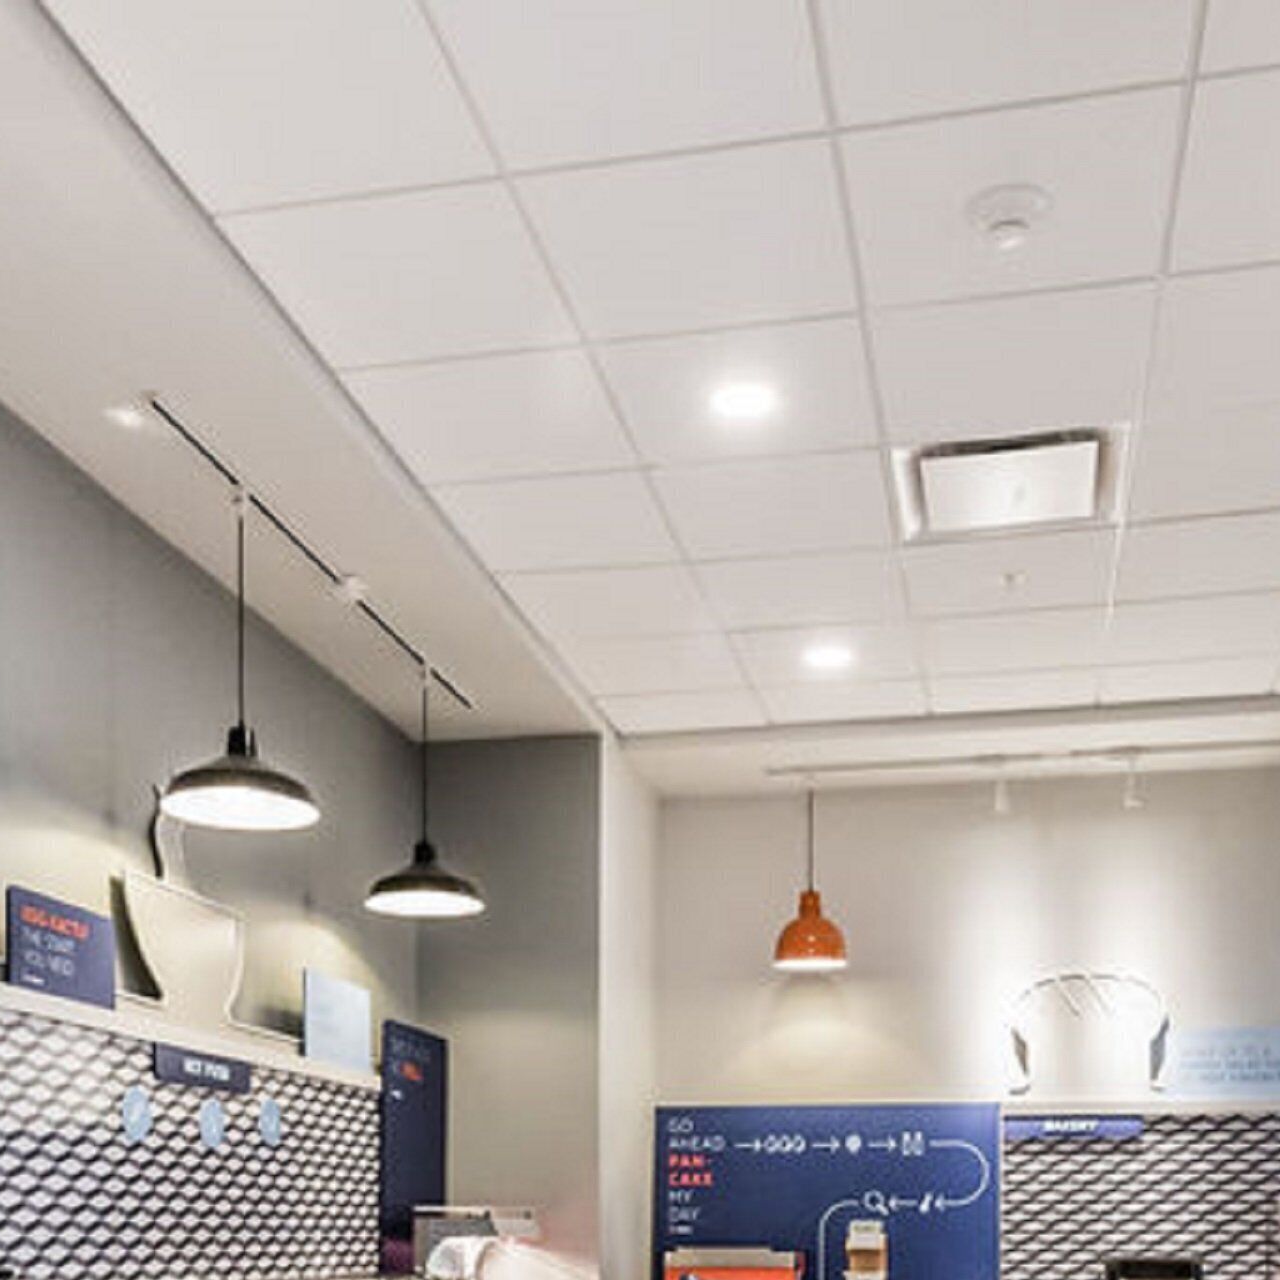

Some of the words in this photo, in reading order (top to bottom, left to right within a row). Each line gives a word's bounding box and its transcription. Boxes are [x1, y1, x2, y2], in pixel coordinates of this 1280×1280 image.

[668, 1117, 694, 1133] GO
[668, 1135, 725, 1151] AHEAD
[668, 1190, 694, 1203] MY
[668, 1206, 700, 1222] DAY
